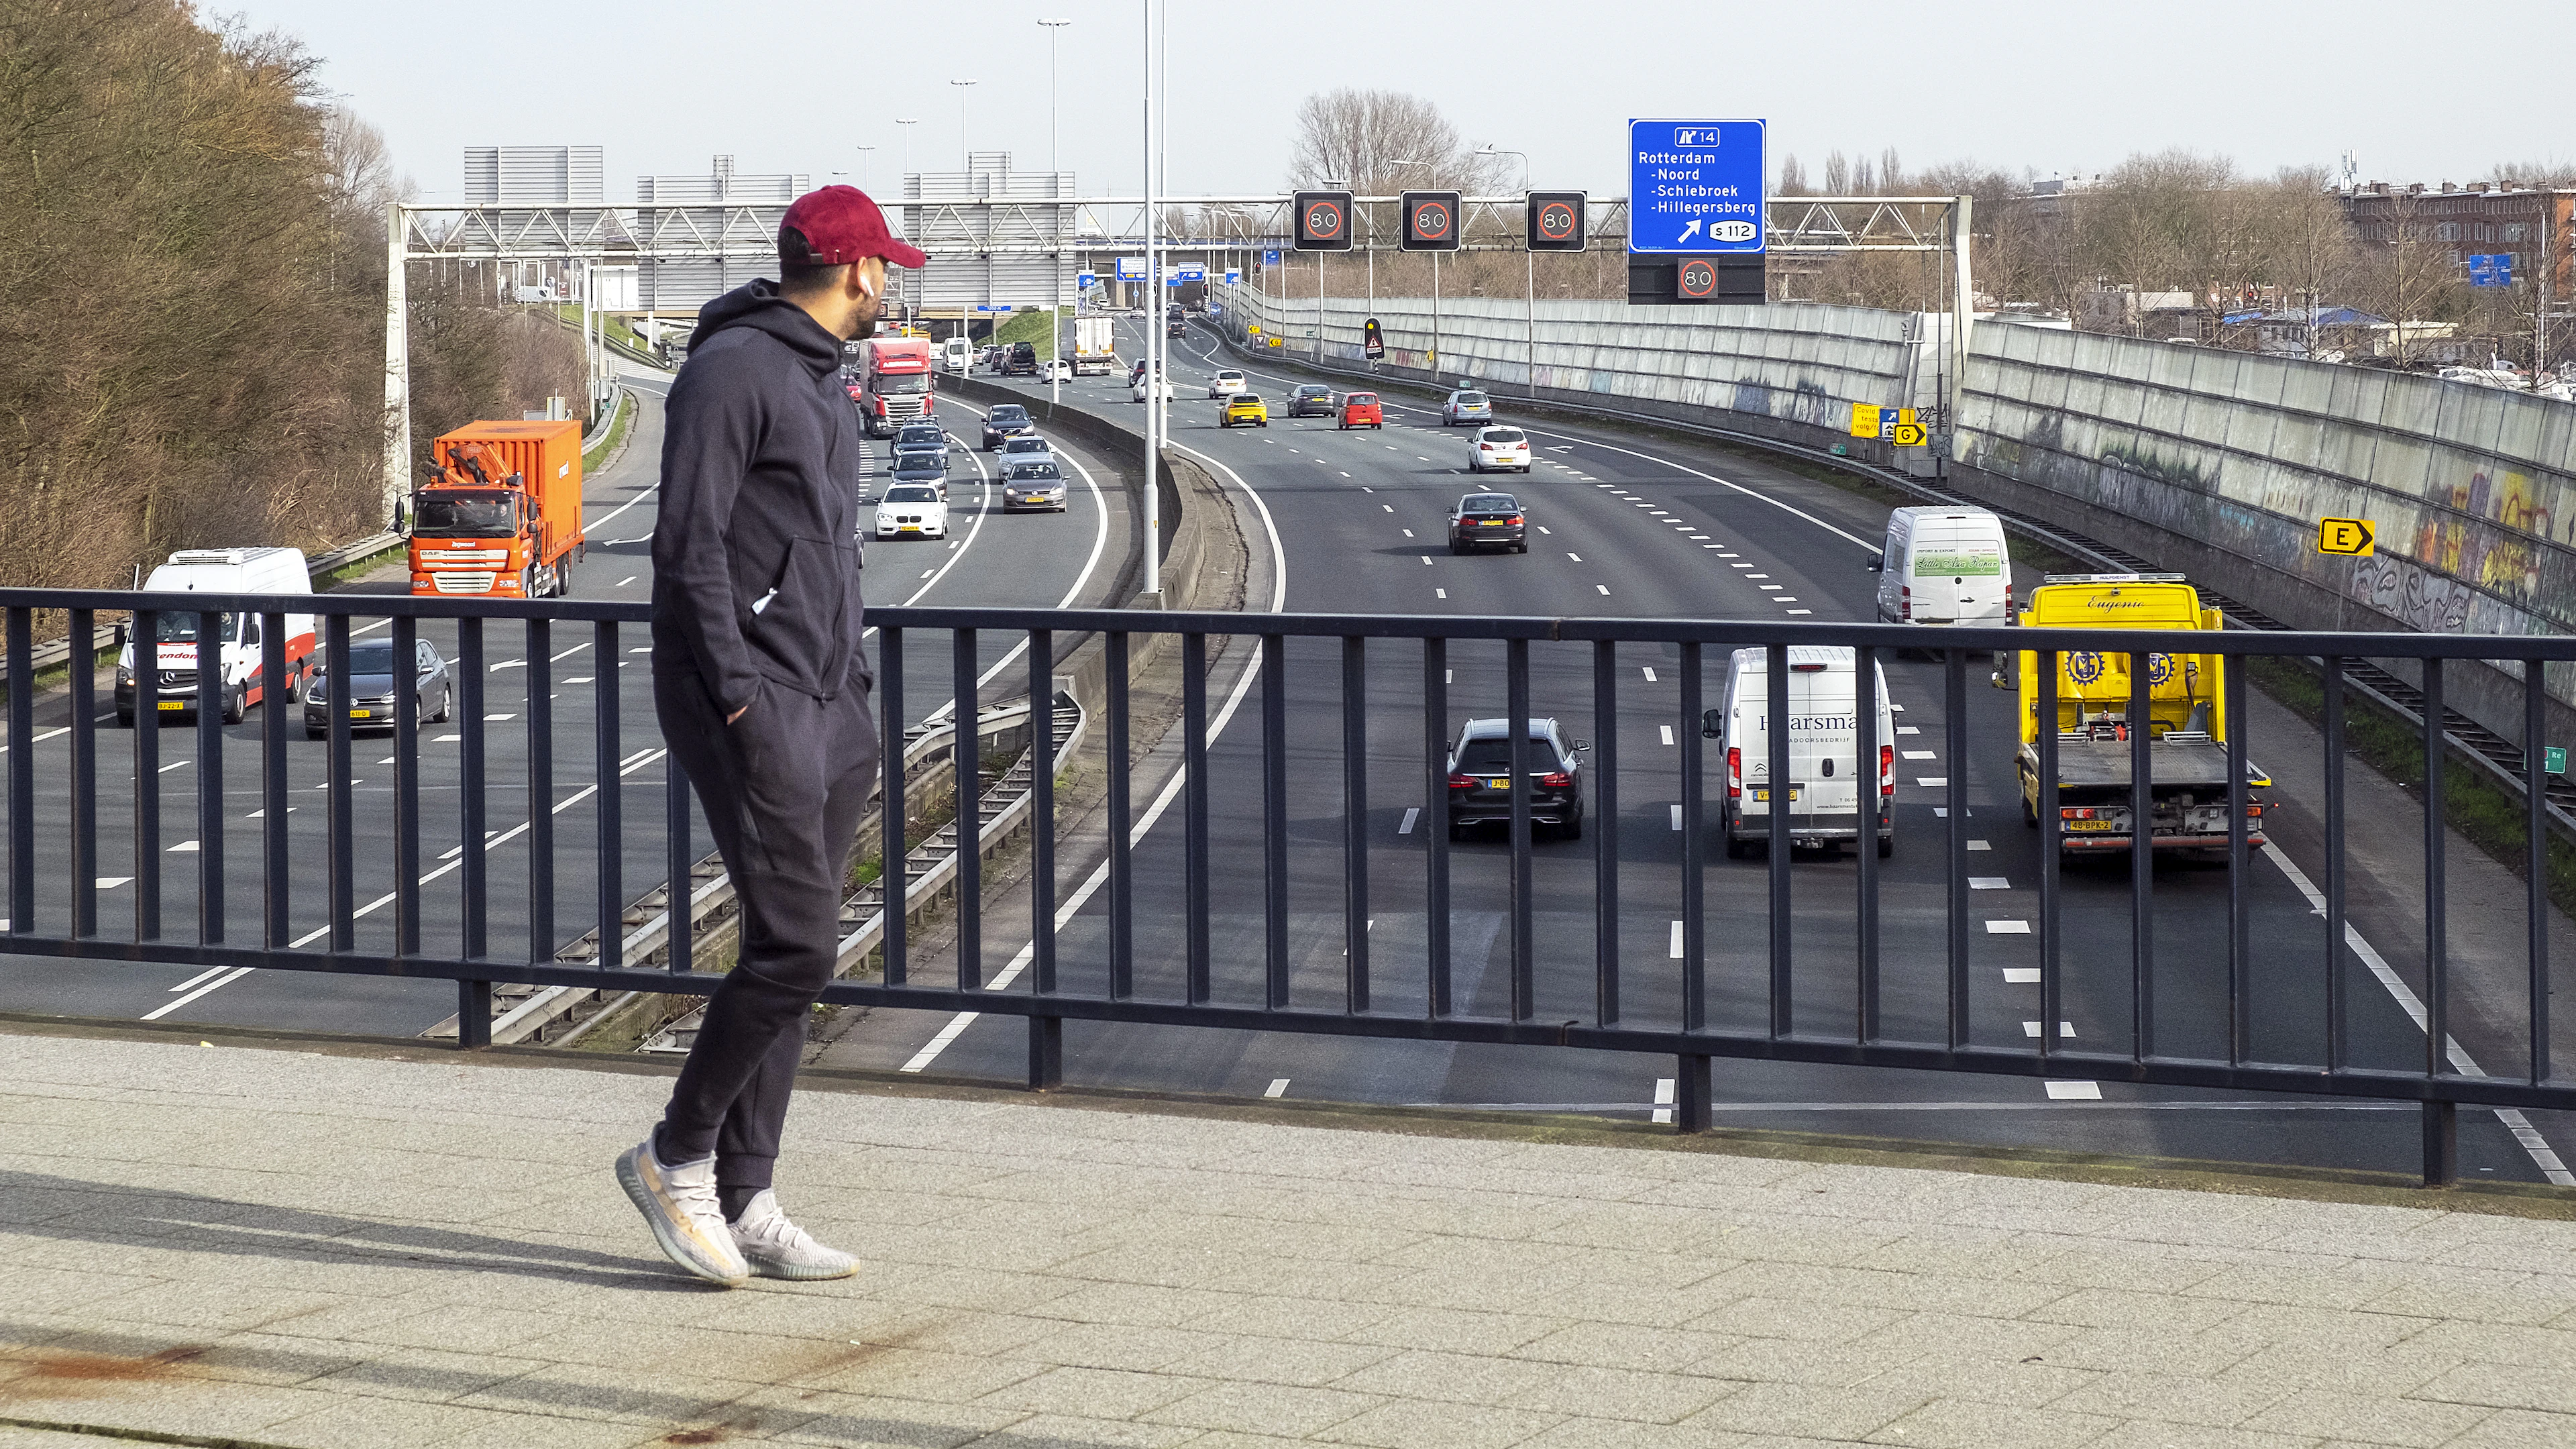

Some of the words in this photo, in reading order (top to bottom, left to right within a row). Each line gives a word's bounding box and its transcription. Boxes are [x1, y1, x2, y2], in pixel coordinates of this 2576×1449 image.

[1700, 132, 1715, 143] 14
[1639, 152, 1716, 164] Rotterdam
[1651, 168, 1700, 180] -Noord
[1651, 184, 1739, 197] -Schiebroek
[1651, 201, 1756, 217] -Hillegersberg
[1310, 213, 1338, 227] 80
[1418, 213, 1446, 228] 80
[1544, 213, 1571, 229] 80
[1715, 227, 1723, 236] s
[1728, 225, 1750, 237] 112
[1684, 271, 1712, 286] 80
[1857, 407, 1876, 415] Covid
[1901, 429, 1911, 440] G
[2337, 528, 2349, 545] E
[1917, 557, 1940, 568] Little
[1759, 715, 1857, 731] Harsma
